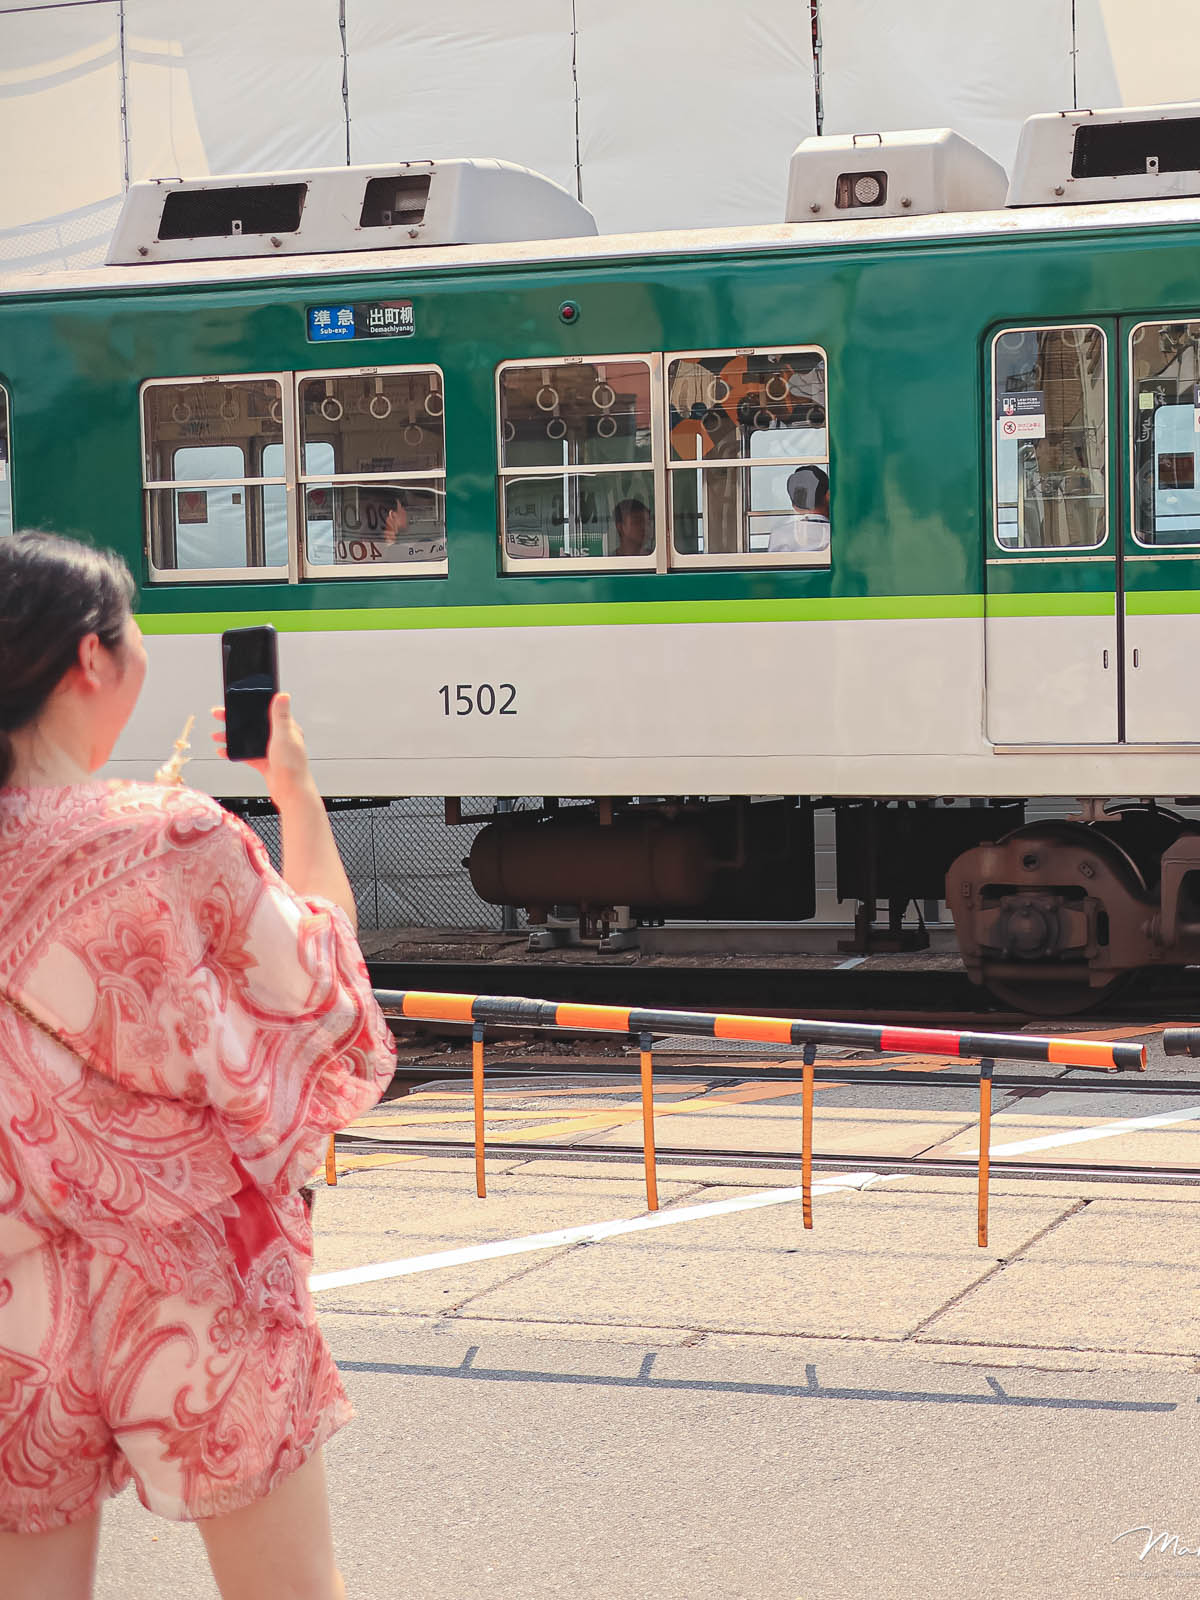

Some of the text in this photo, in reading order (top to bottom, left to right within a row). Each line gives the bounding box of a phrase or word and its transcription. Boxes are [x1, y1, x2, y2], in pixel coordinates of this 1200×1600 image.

[314, 309, 354, 327] 準急
[370, 306, 413, 326] 出町柳
[320, 327, 348, 335] Sub-exp.
[438, 683, 517, 716] 1502
